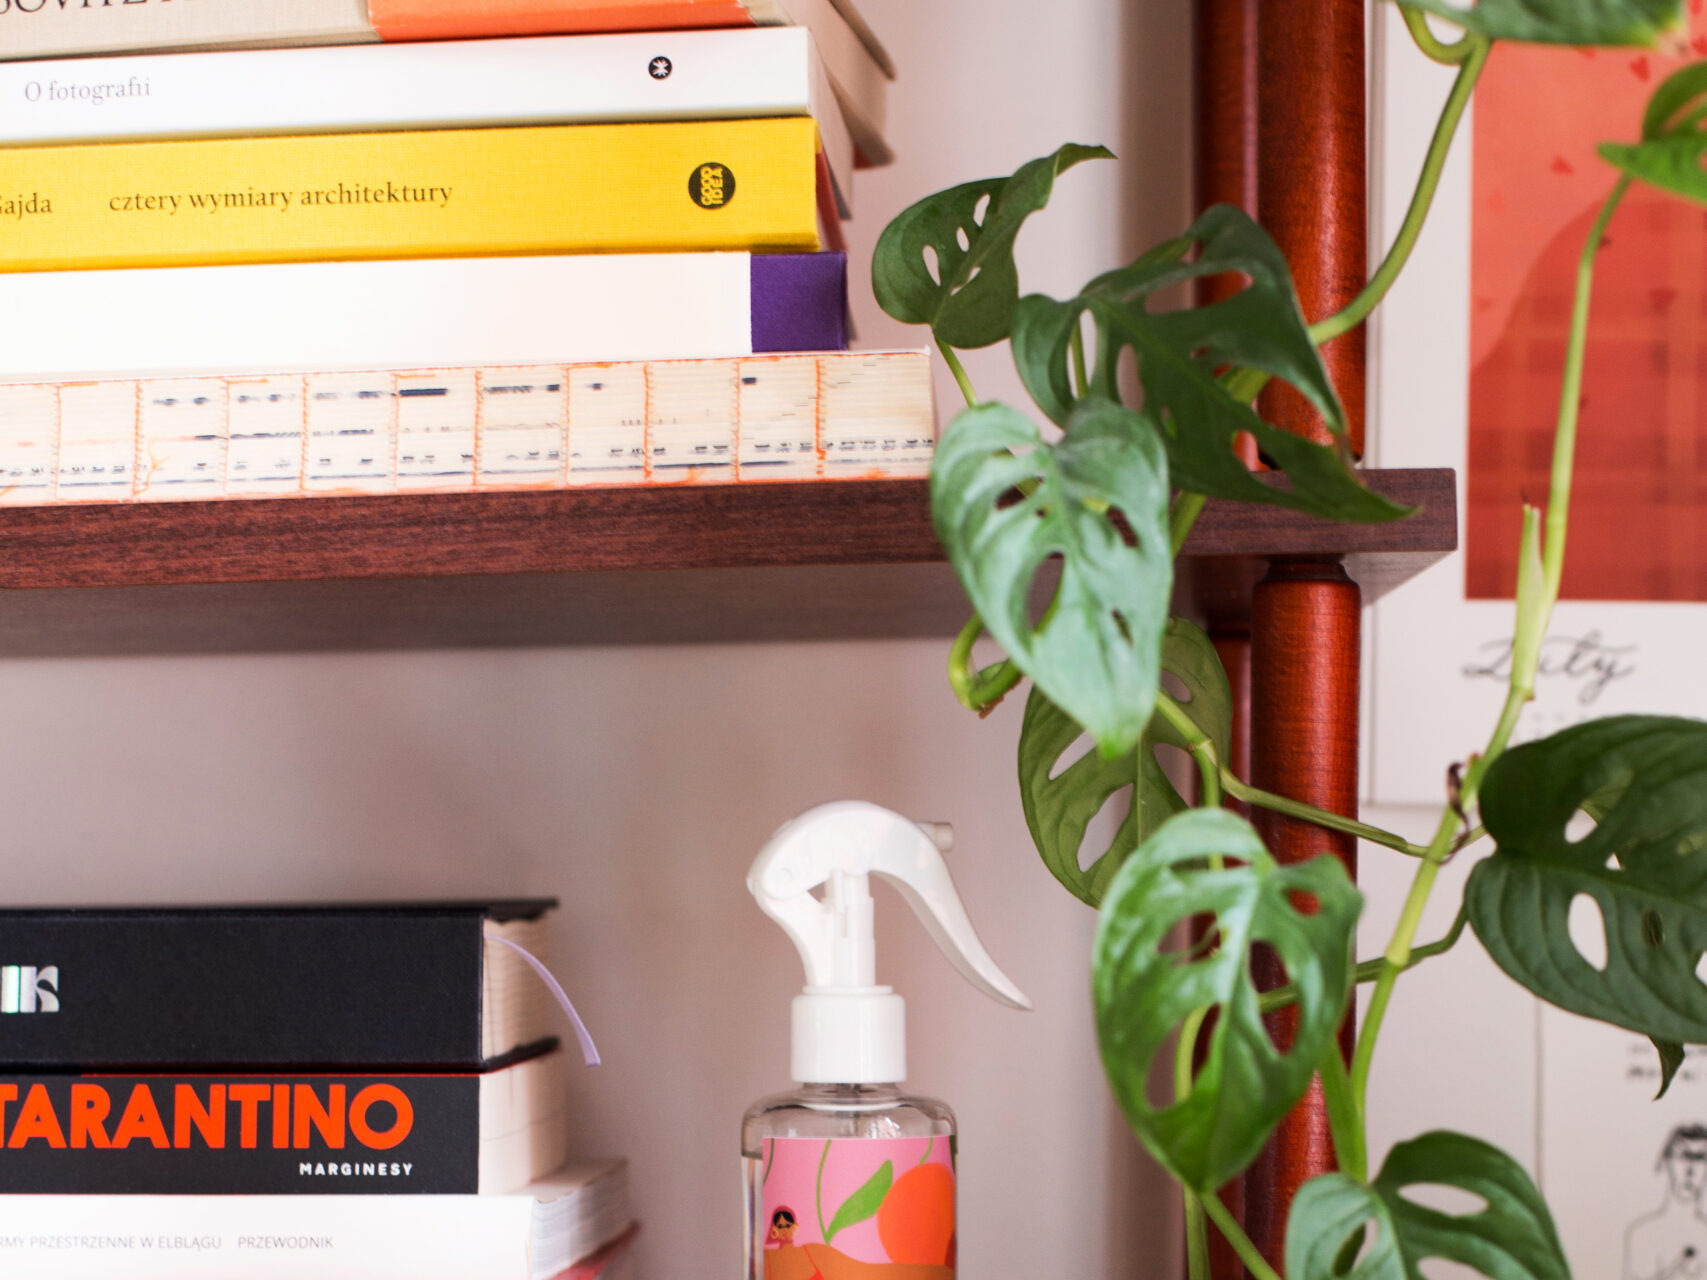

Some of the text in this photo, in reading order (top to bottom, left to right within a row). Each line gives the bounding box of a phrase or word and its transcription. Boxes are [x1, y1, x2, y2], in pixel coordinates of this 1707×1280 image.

[24, 77, 151, 105] O fotografii
[0, 182, 453, 220] ajda cztery wymiary architektury
[300, 1162, 413, 1176] MARGINESY
[30, 1236, 138, 1249] PRZESTRZENNE
[140, 1236, 153, 1248] W
[238, 1236, 333, 1249] PRZEWODNIK
